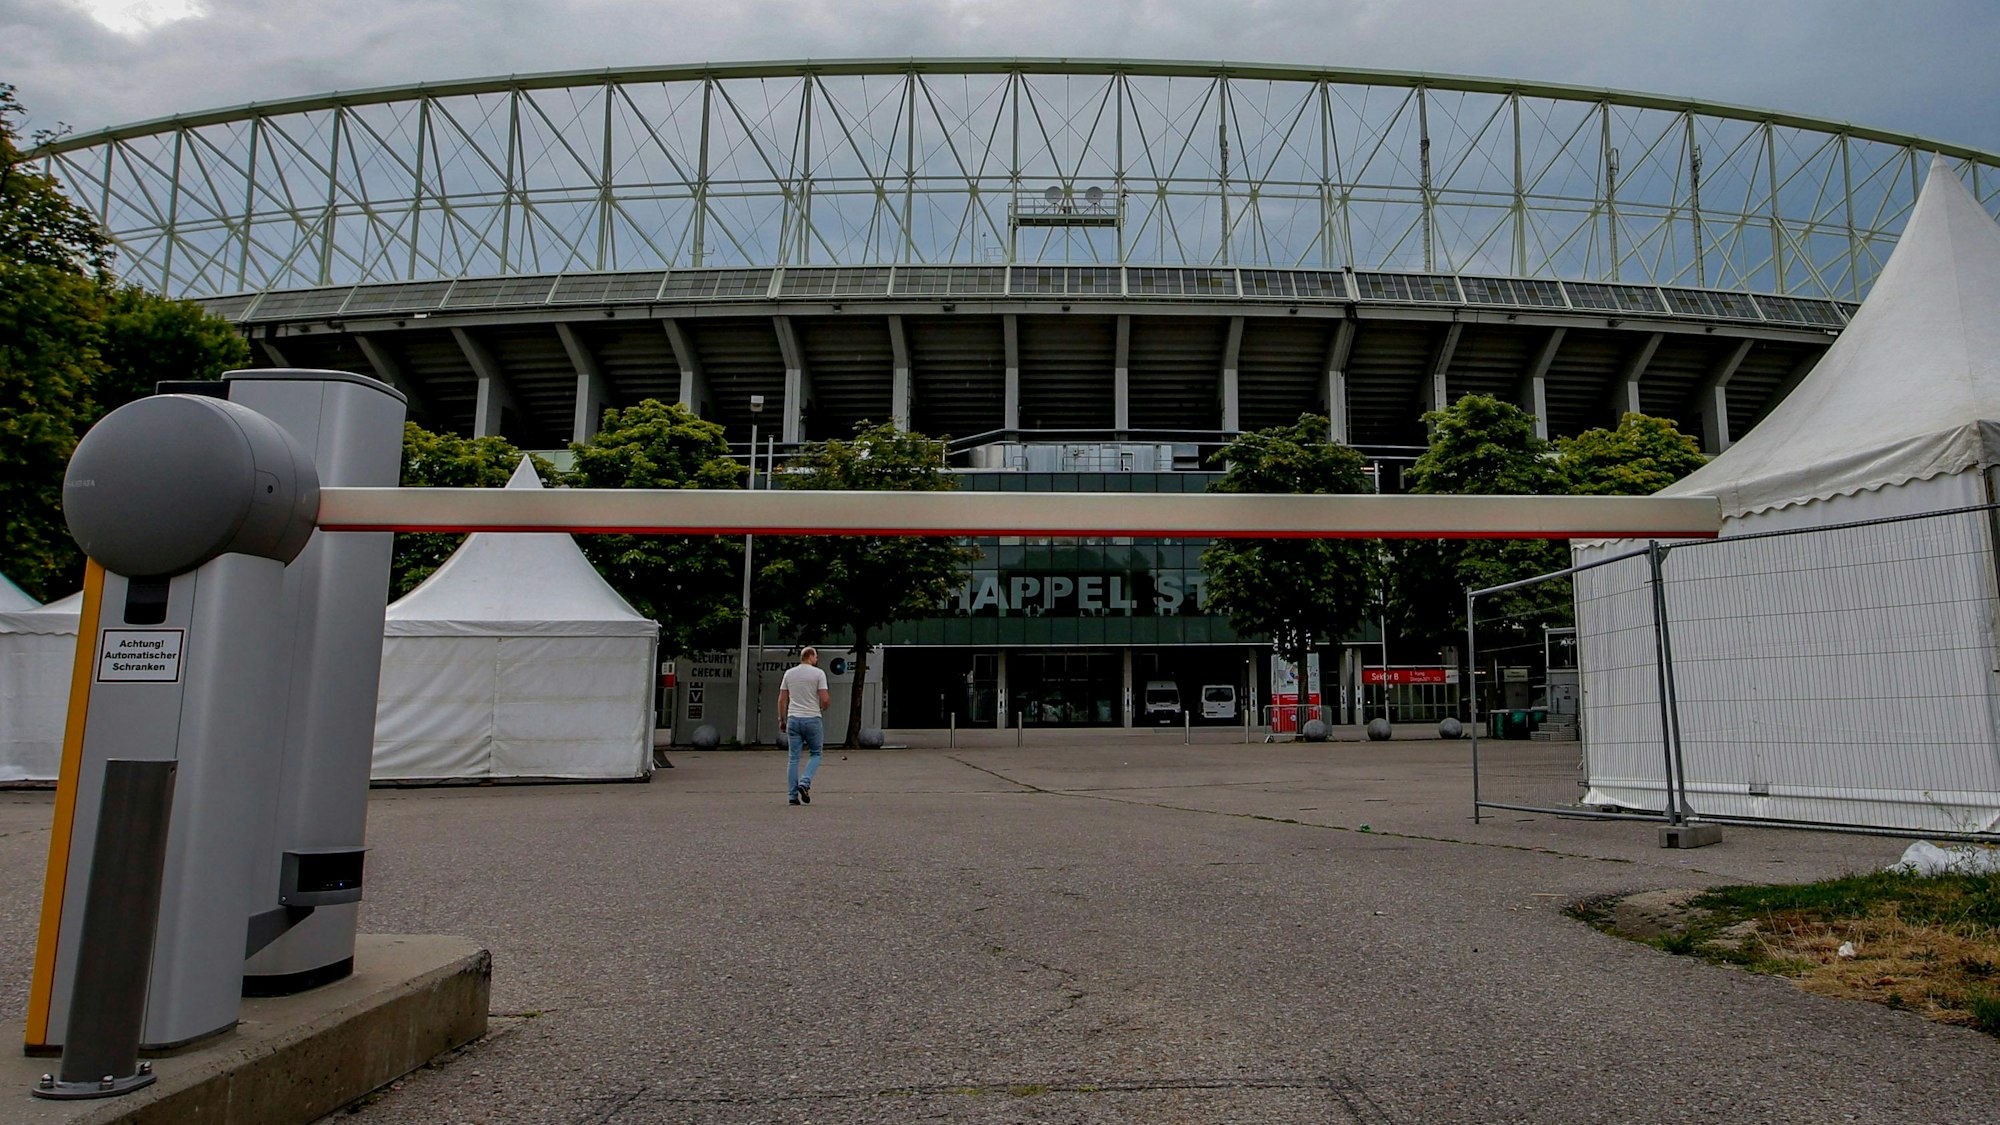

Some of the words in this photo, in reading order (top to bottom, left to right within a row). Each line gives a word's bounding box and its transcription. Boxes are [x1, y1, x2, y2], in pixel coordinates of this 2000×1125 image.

[119, 639, 165, 650] Achtung!
[104, 650, 178, 660] Automatischer
[692, 653, 734, 664] SECURITY
[112, 662, 166, 672] Schranken
[691, 667, 721, 678] CHECK
[722, 667, 733, 679] IN
[1394, 672, 1400, 681] B
